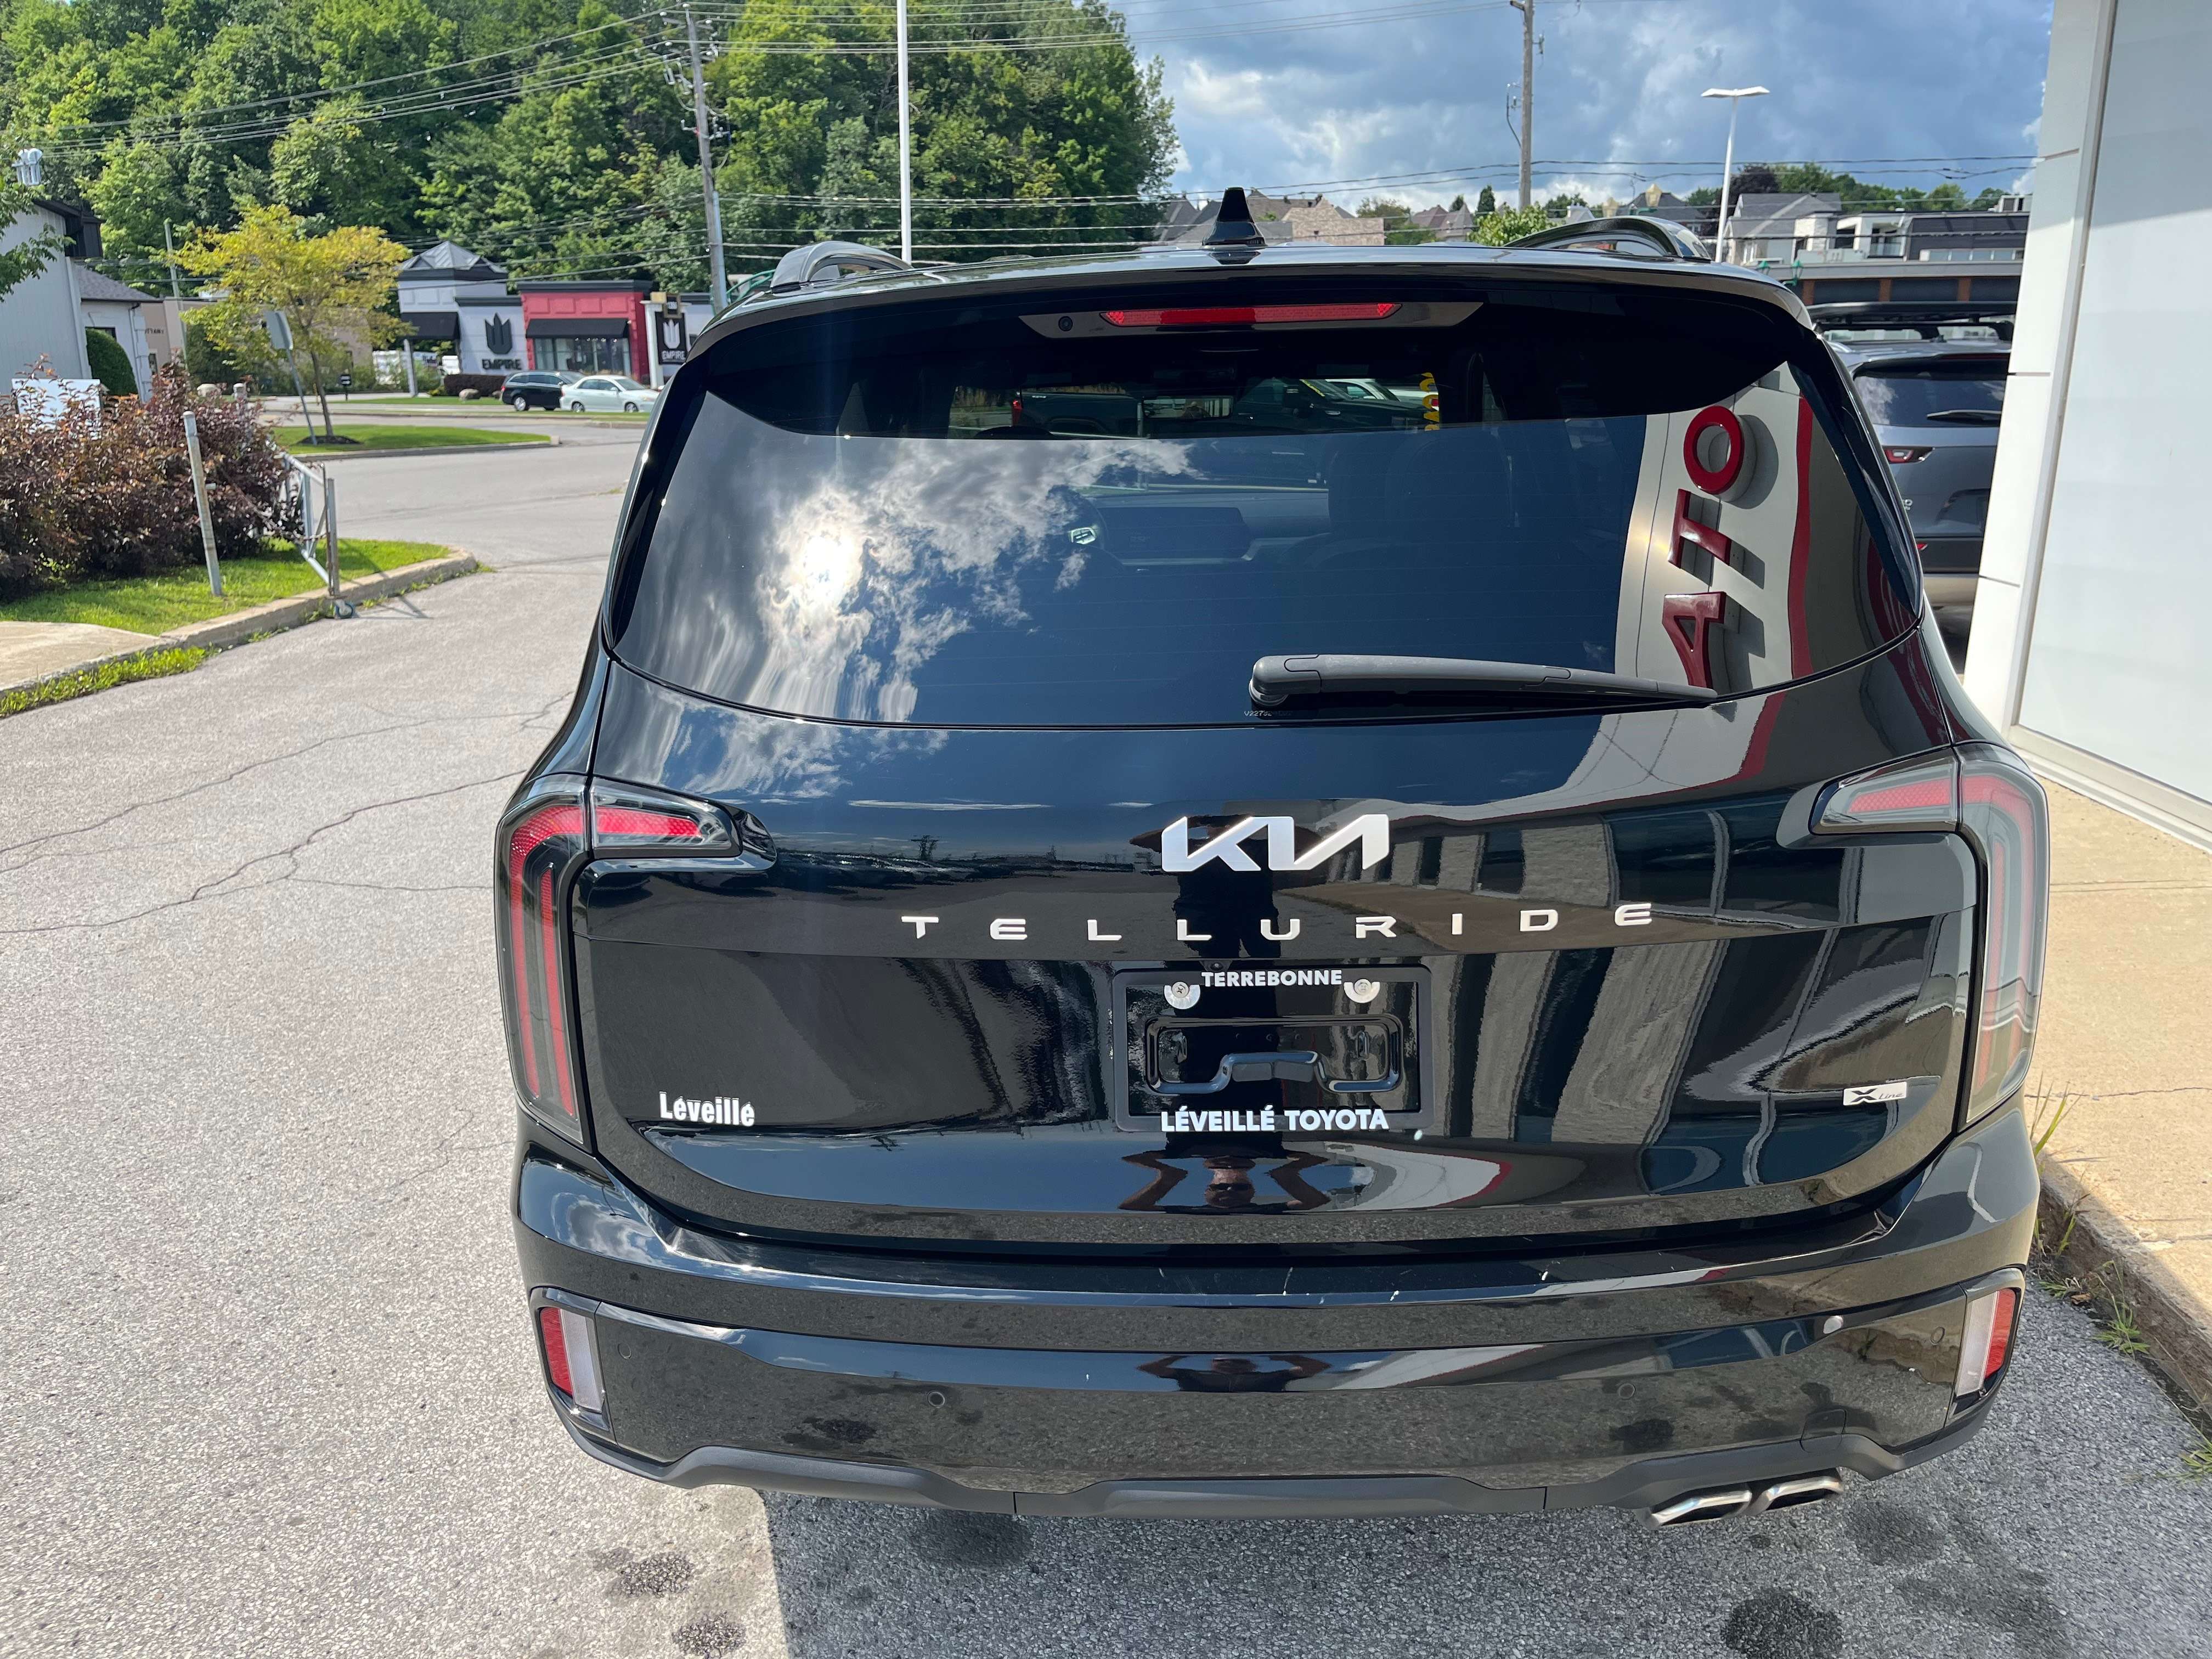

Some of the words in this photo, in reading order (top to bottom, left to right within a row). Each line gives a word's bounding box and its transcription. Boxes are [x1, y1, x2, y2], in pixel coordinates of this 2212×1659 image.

[482, 359, 522, 370] EMPIRE
[661, 350, 686, 360] EMPIRE
[1161, 814, 1390, 872] KIA
[901, 902, 1653, 941] TELLURIDE
[1200, 969, 1342, 987] TERREBONNE
[1161, 1104, 1275, 1132] LÉVEILLÉ
[1284, 1108, 1389, 1131] TOYOTA
